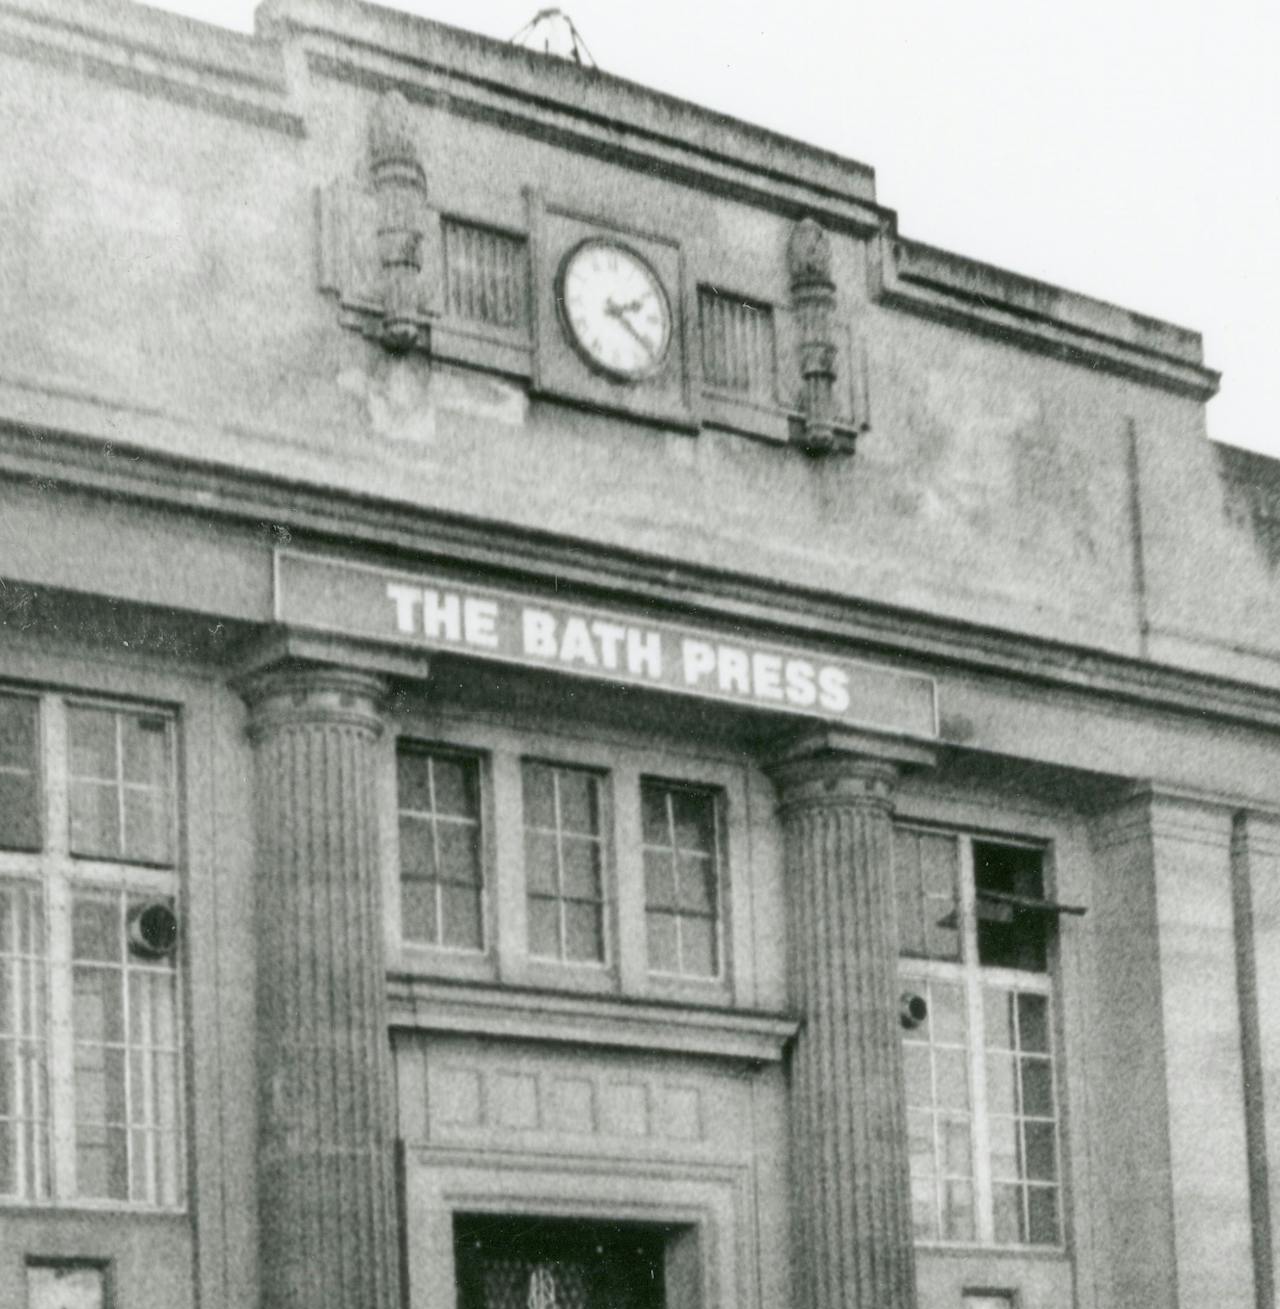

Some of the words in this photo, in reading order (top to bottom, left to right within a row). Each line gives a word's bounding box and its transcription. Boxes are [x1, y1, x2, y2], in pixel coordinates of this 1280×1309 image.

[387, 583, 498, 647] THE
[522, 609, 662, 678] BATH
[681, 639, 851, 711] PRESS
